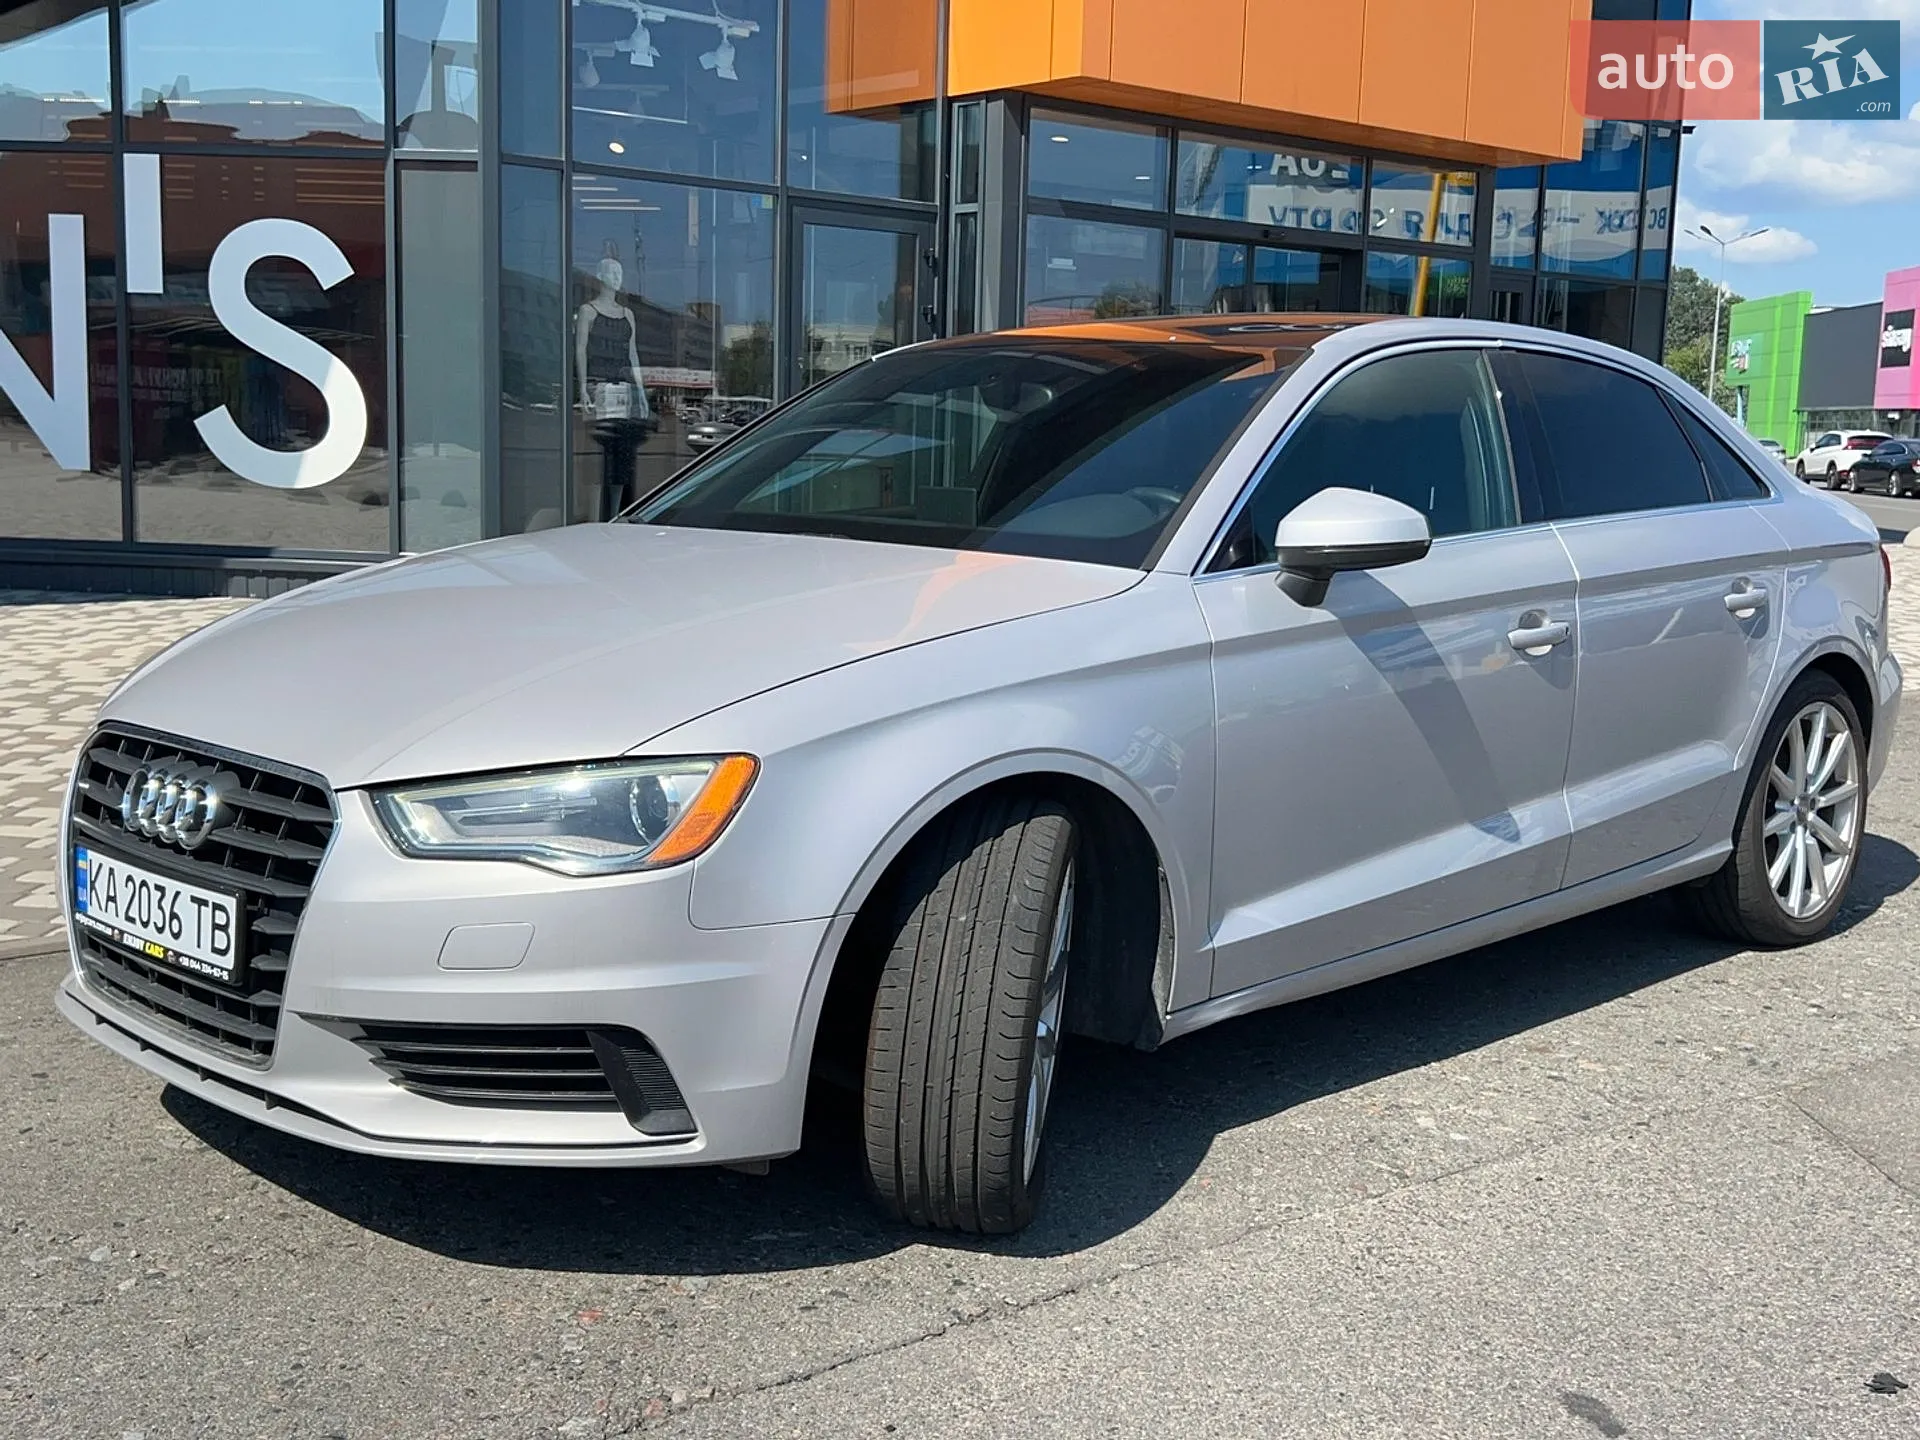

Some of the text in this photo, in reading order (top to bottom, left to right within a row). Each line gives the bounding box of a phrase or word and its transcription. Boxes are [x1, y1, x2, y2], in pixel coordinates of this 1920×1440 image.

[89, 859, 119, 918] KA
[124, 874, 182, 940] 2036
[190, 895, 231, 957] TB
